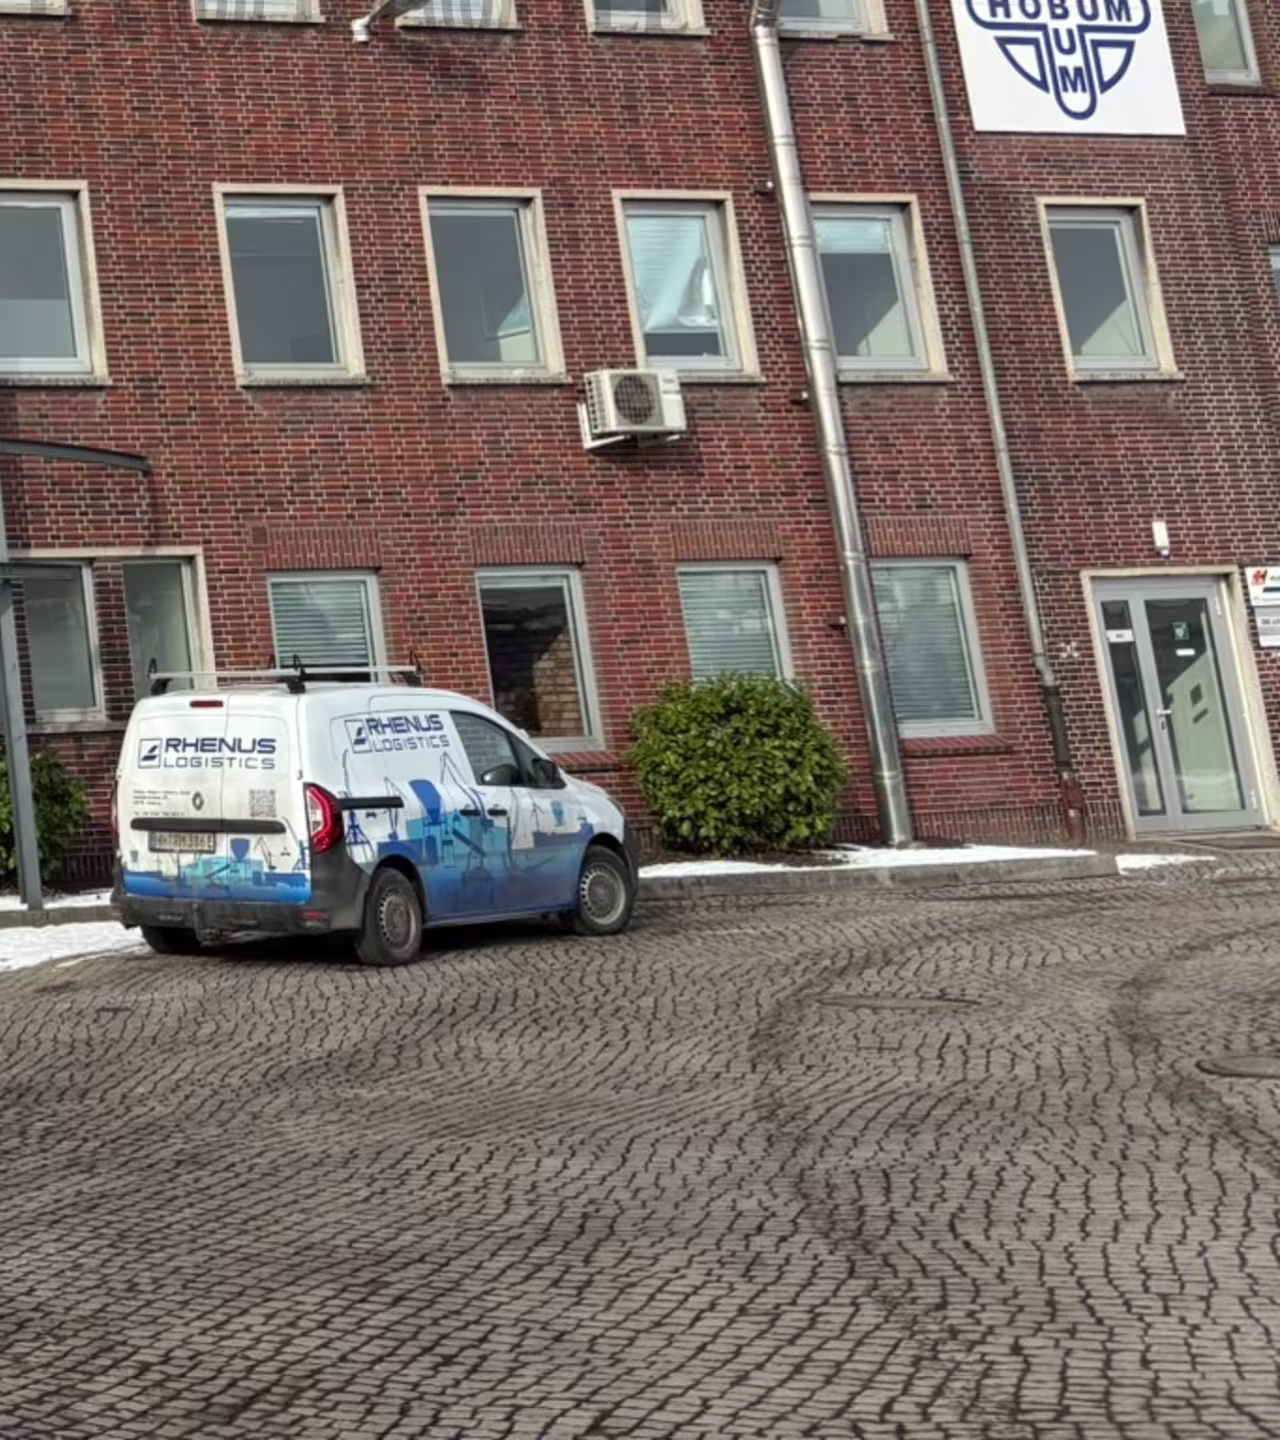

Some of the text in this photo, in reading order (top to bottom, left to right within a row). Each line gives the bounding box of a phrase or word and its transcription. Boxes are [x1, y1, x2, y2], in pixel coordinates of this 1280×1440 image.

[365, 714, 444, 735] RHENUS
[165, 737, 276, 754] RHENUS
[372, 734, 450, 752] LOGISTICS
[164, 756, 276, 769] LOGISTICS
